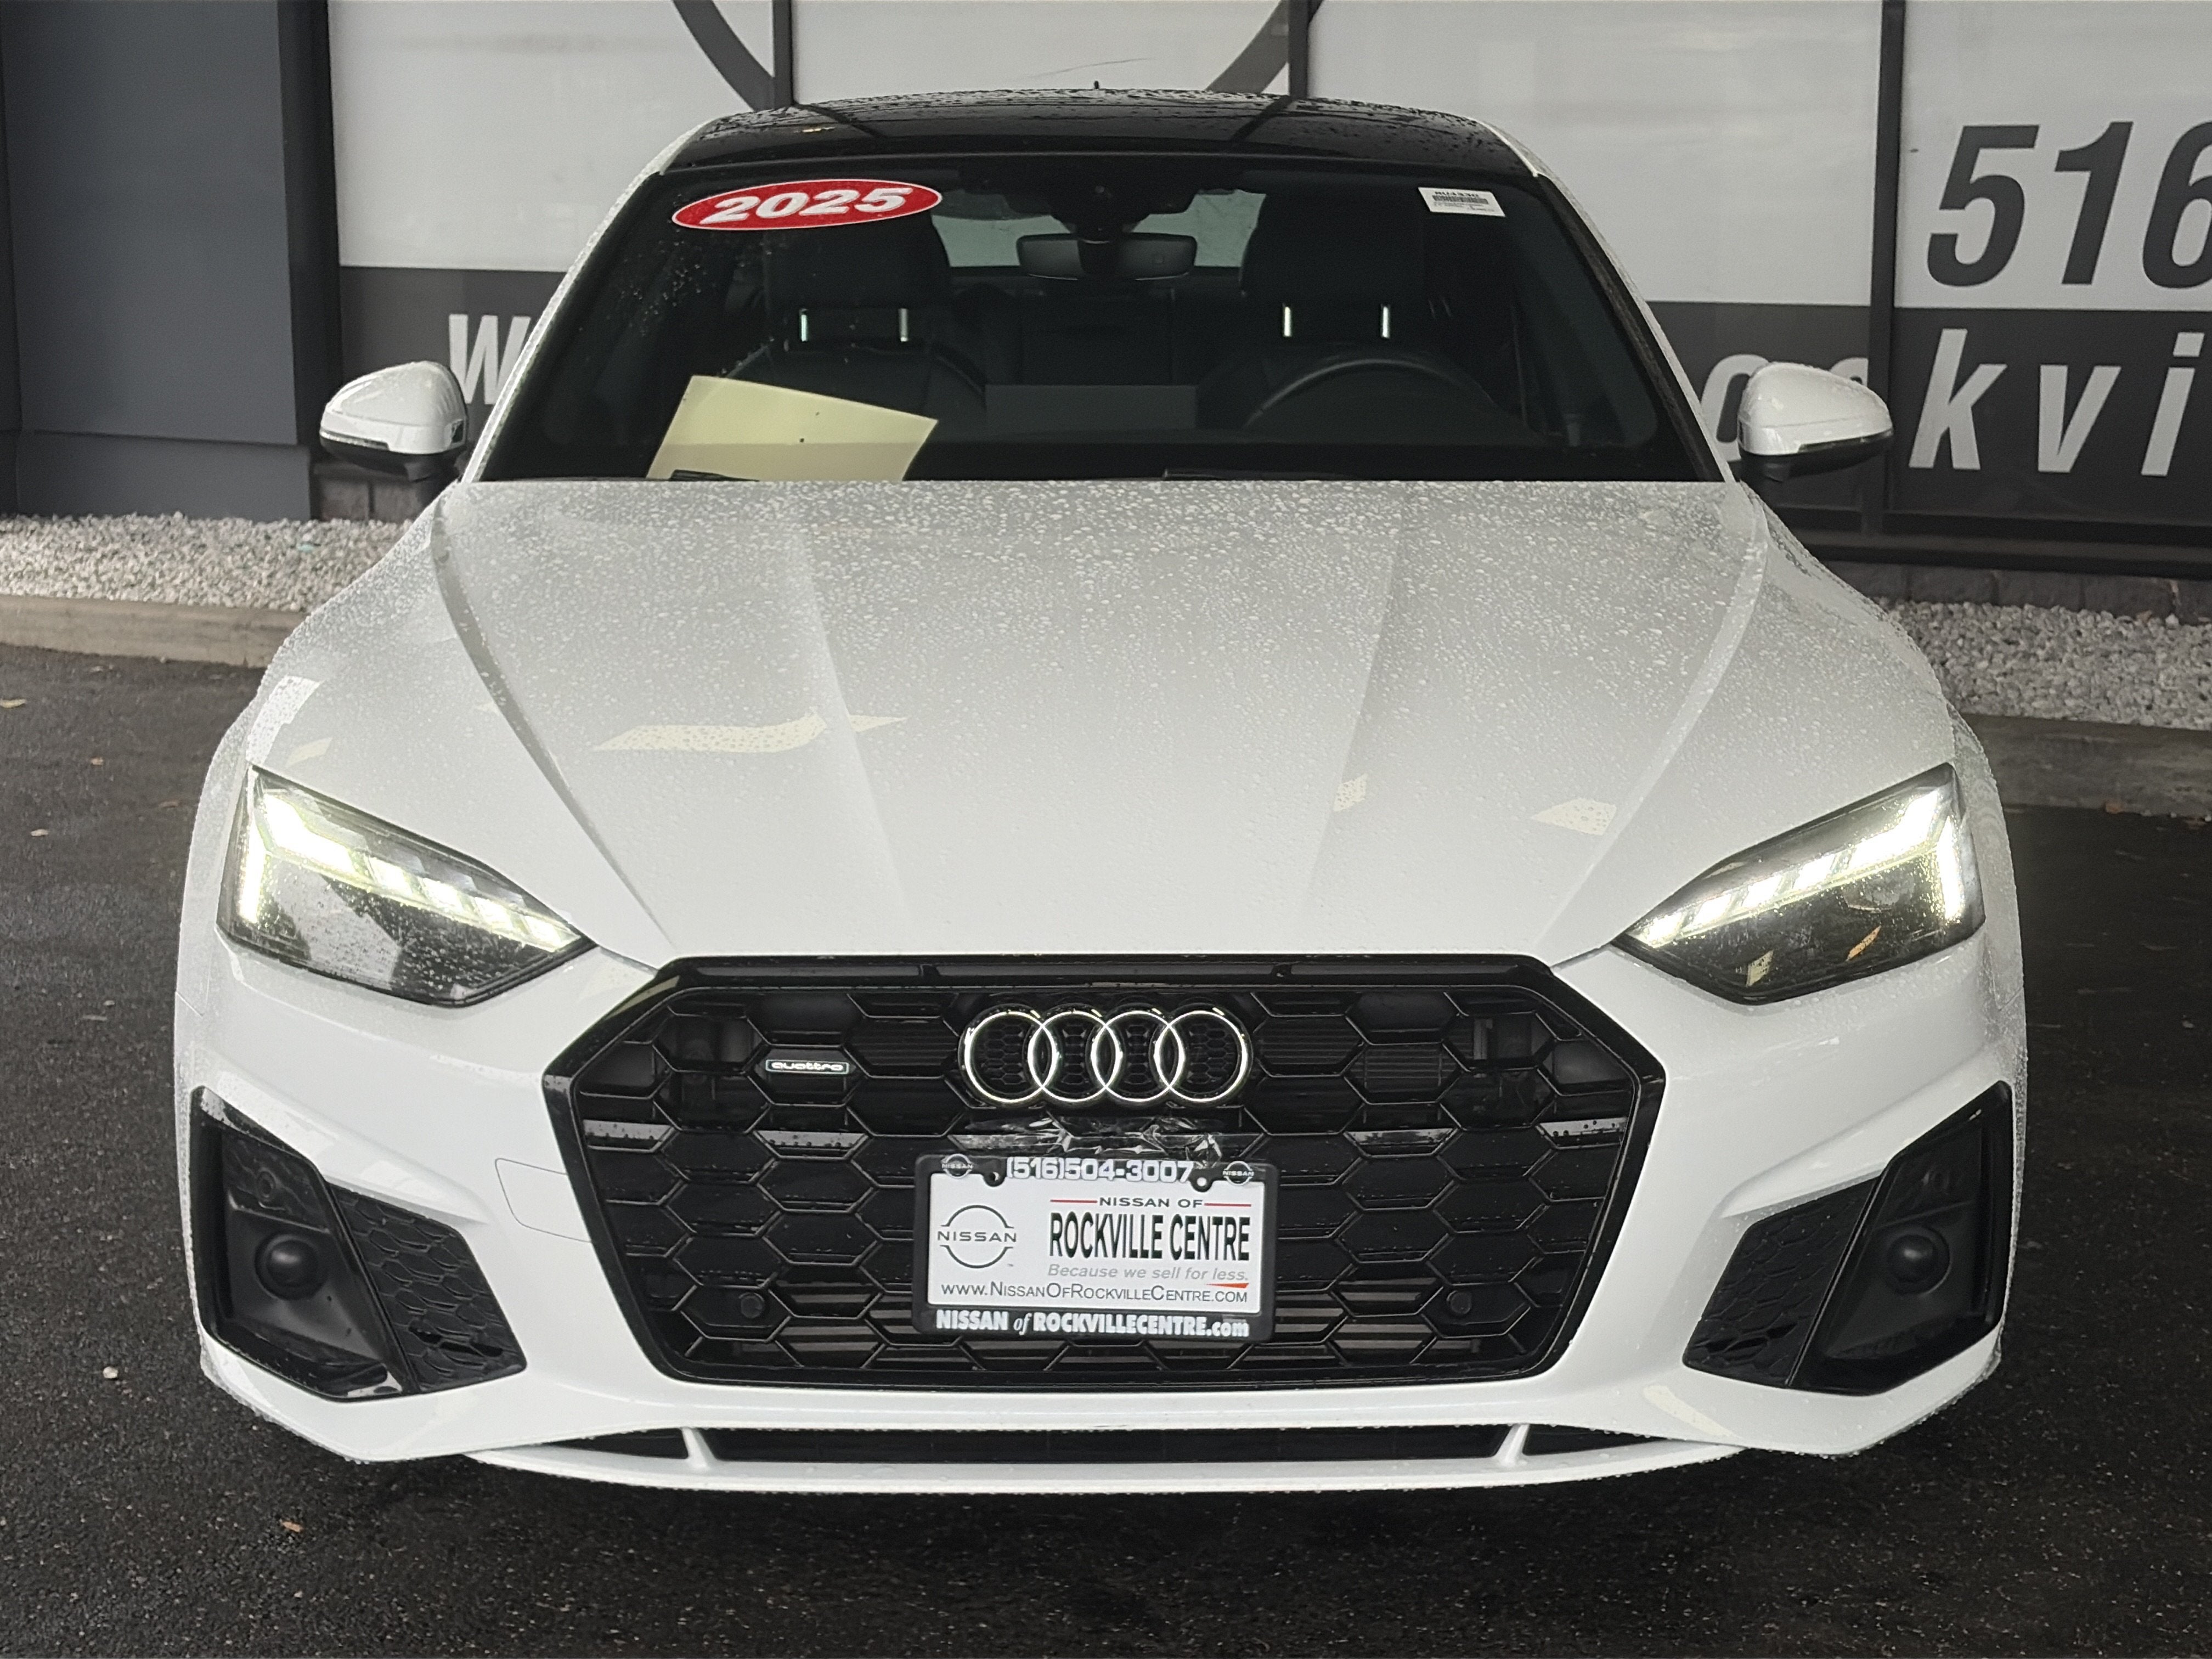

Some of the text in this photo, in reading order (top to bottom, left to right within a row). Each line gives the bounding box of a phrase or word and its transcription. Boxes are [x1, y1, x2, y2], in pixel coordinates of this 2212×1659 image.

[700, 187, 913, 224] 2025
[1927, 121, 2212, 289] 516
[771, 1062, 844, 1071] quattro
[1007, 1156, 1194, 1183] (516)504-3007
[1099, 1197, 1204, 1208] NISSAN OF
[937, 1231, 1017, 1243] NISSAN
[1049, 1211, 1251, 1261] ROCKVILLE CENTRE
[1047, 1263, 1249, 1281] Because we sell for less.
[936, 1309, 1250, 1338] NISSAN of ROCKVILLECENTRE.com
